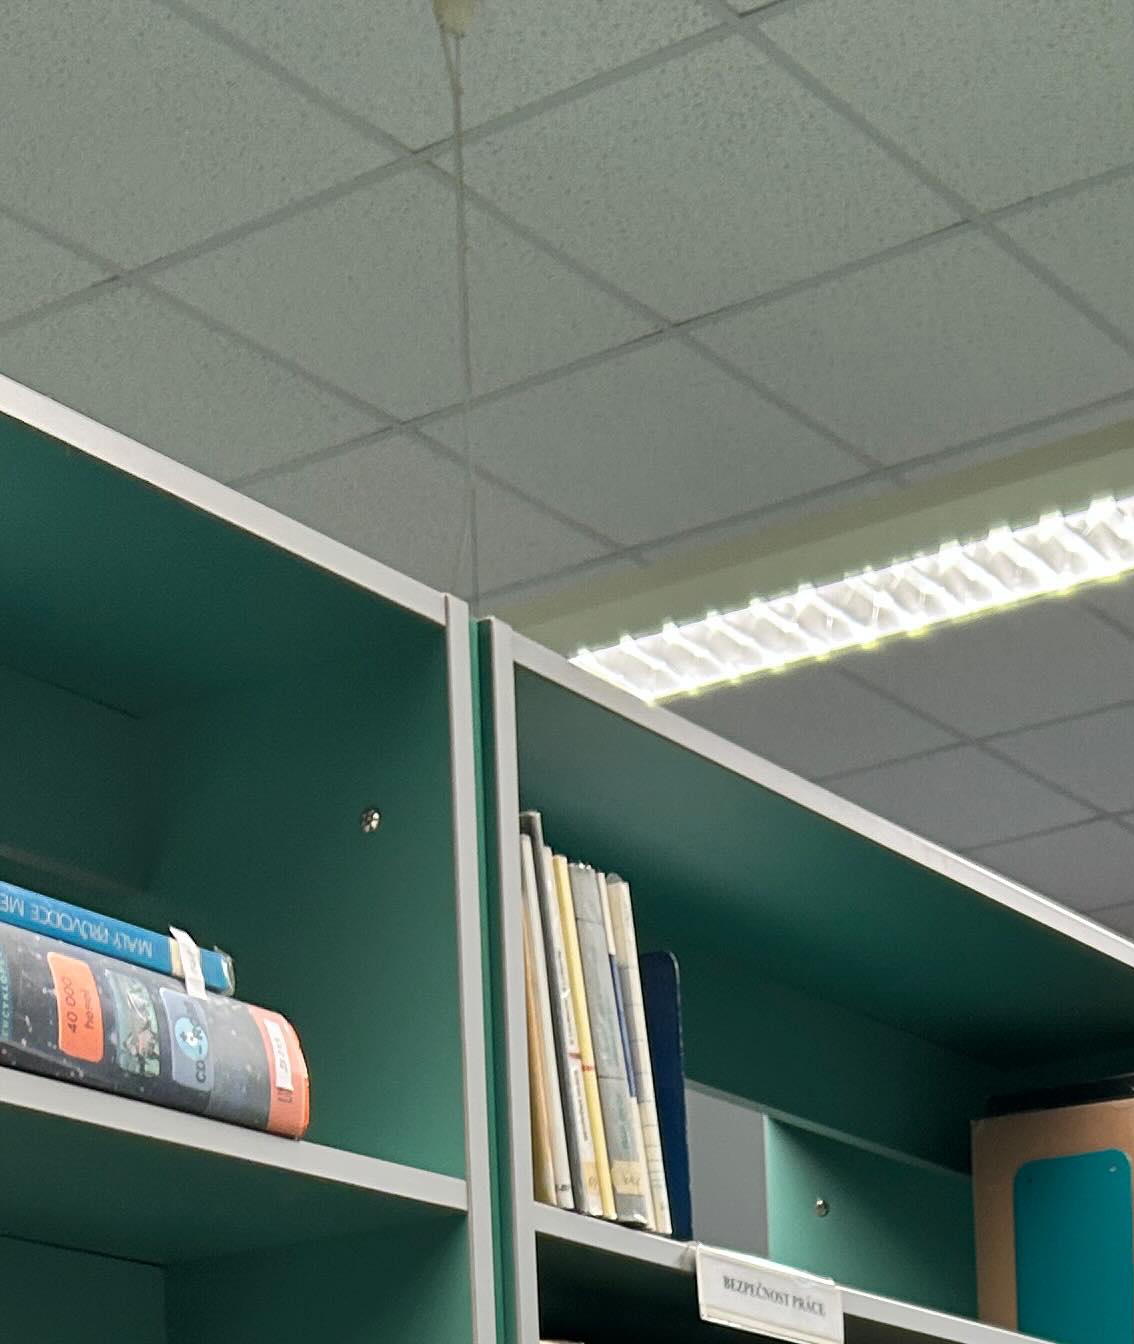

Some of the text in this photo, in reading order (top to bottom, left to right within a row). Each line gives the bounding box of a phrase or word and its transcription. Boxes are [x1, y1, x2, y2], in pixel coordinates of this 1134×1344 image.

[66, 1011, 78, 1033] 40
[195, 1059, 207, 1084] CD
[722, 1274, 826, 1317] BEZPEČNOST PRÁCE
